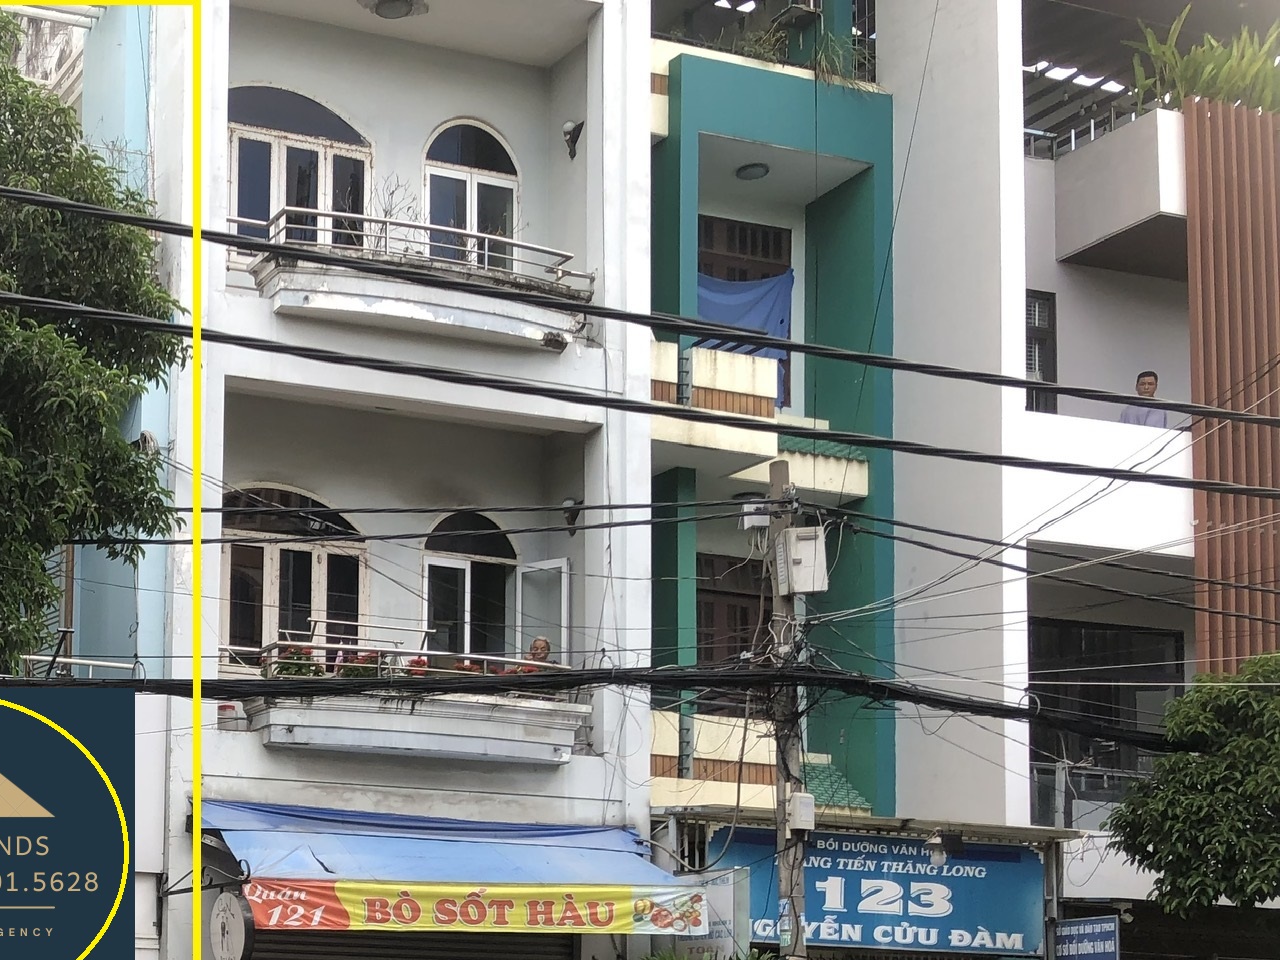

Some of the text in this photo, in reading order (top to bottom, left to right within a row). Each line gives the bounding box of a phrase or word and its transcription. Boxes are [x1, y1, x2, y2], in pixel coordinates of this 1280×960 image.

[842, 840, 888, 855] DƯỠNG
[891, 844, 916, 857] VĂN
[836, 854, 877, 872] TIẾN
[941, 864, 988, 879] LONG
[243, 882, 310, 904] Quán
[815, 876, 954, 917] 123
[267, 904, 326, 926] 121
[363, 887, 616, 928] BÒ SỐT HÀU
[873, 922, 940, 947] CỬU
[948, 926, 1025, 950] ĐÀM
